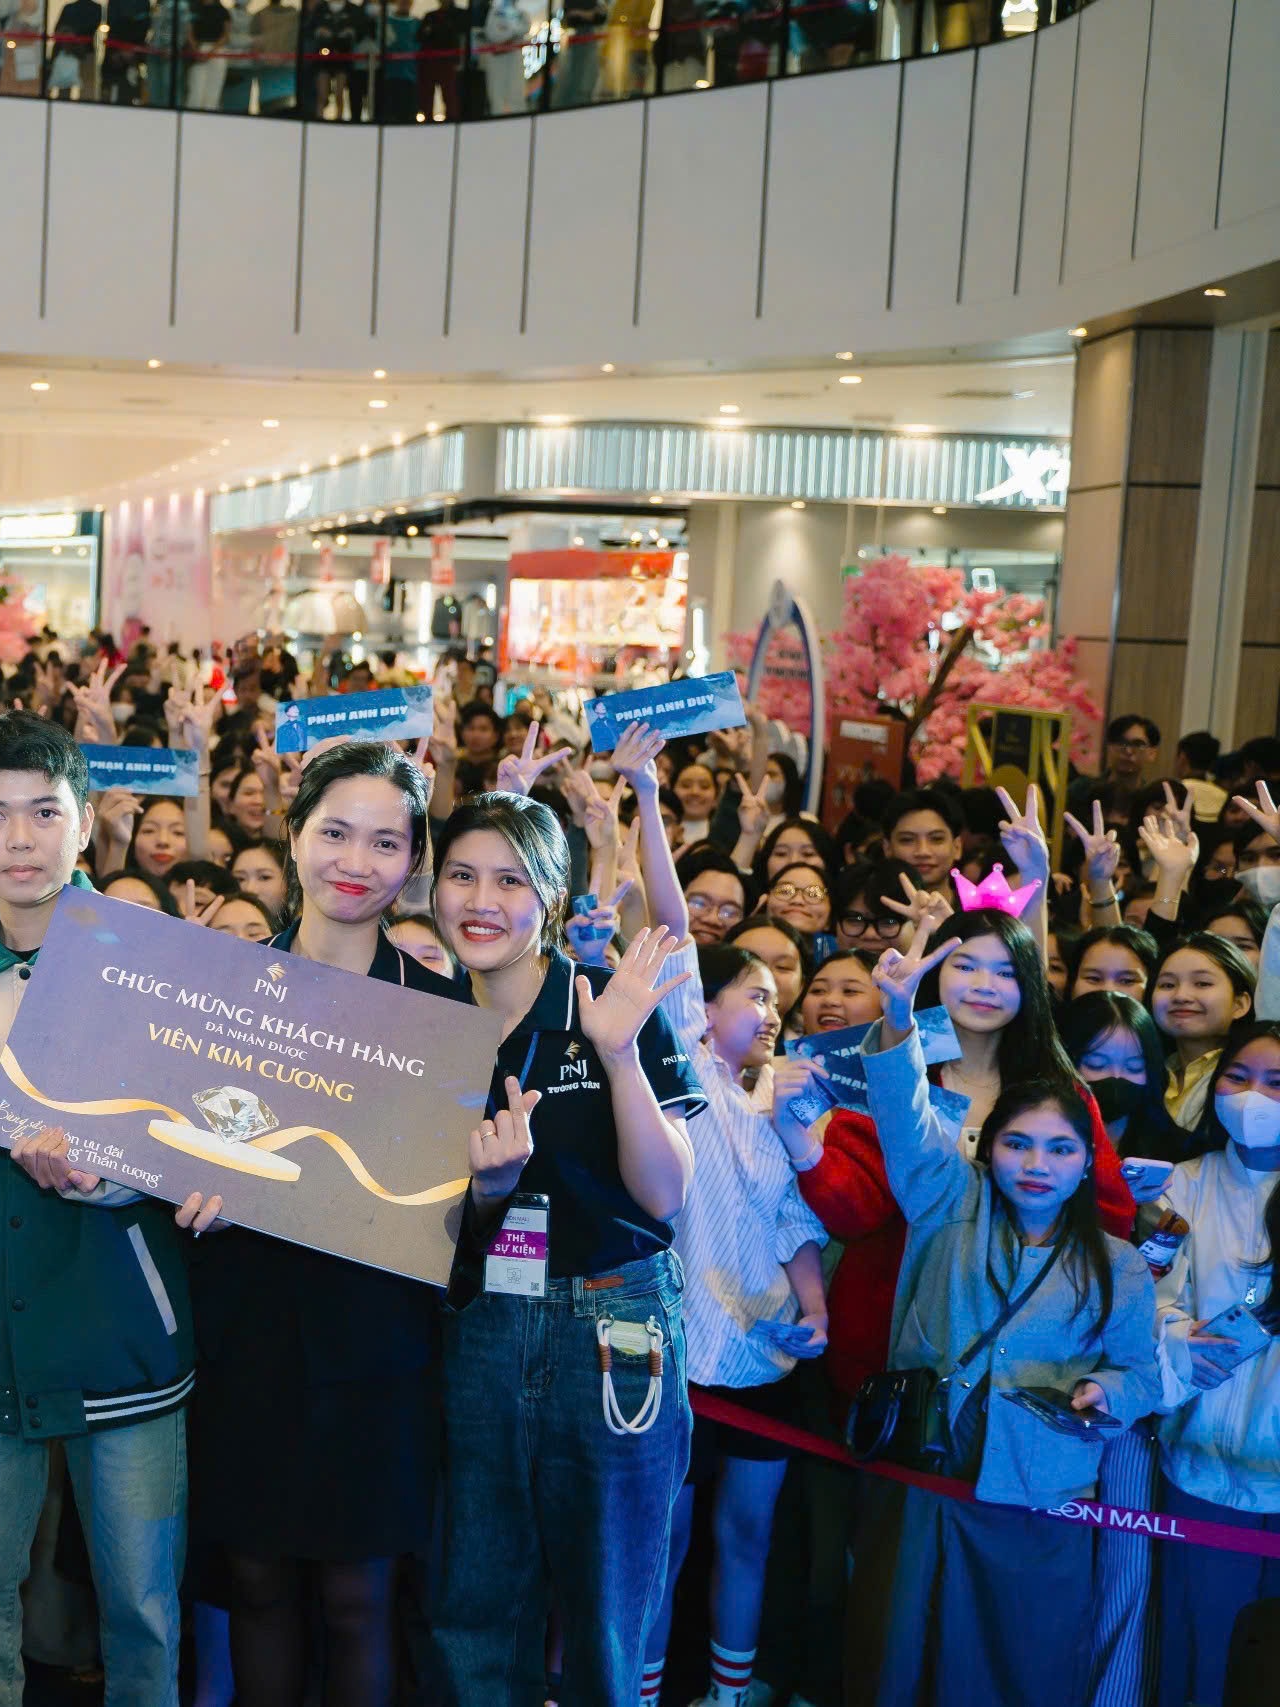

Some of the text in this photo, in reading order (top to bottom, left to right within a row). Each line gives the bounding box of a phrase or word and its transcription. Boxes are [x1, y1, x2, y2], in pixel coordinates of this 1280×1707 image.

[307, 705, 409, 726] PHẠM ANH DUY
[615, 694, 715, 722] PHẠM ANH DUY
[89, 761, 177, 773] PHẠM ANH DUY
[254, 978, 288, 1003] PNJ
[101, 966, 426, 1077] CHÚC MỪNG KHÁCH HÀNG
[205, 1021, 309, 1061] ĐÃ NHẬN ĐƯỢC
[148, 1022, 355, 1102] VIÊN KIM CƯƠNG
[559, 1059, 588, 1080] PNJ
[494, 1244, 536, 1256] SỰ KIỆN
[506, 1232, 526, 1243] THẺ
[1109, 1509, 1186, 1538] MALL
